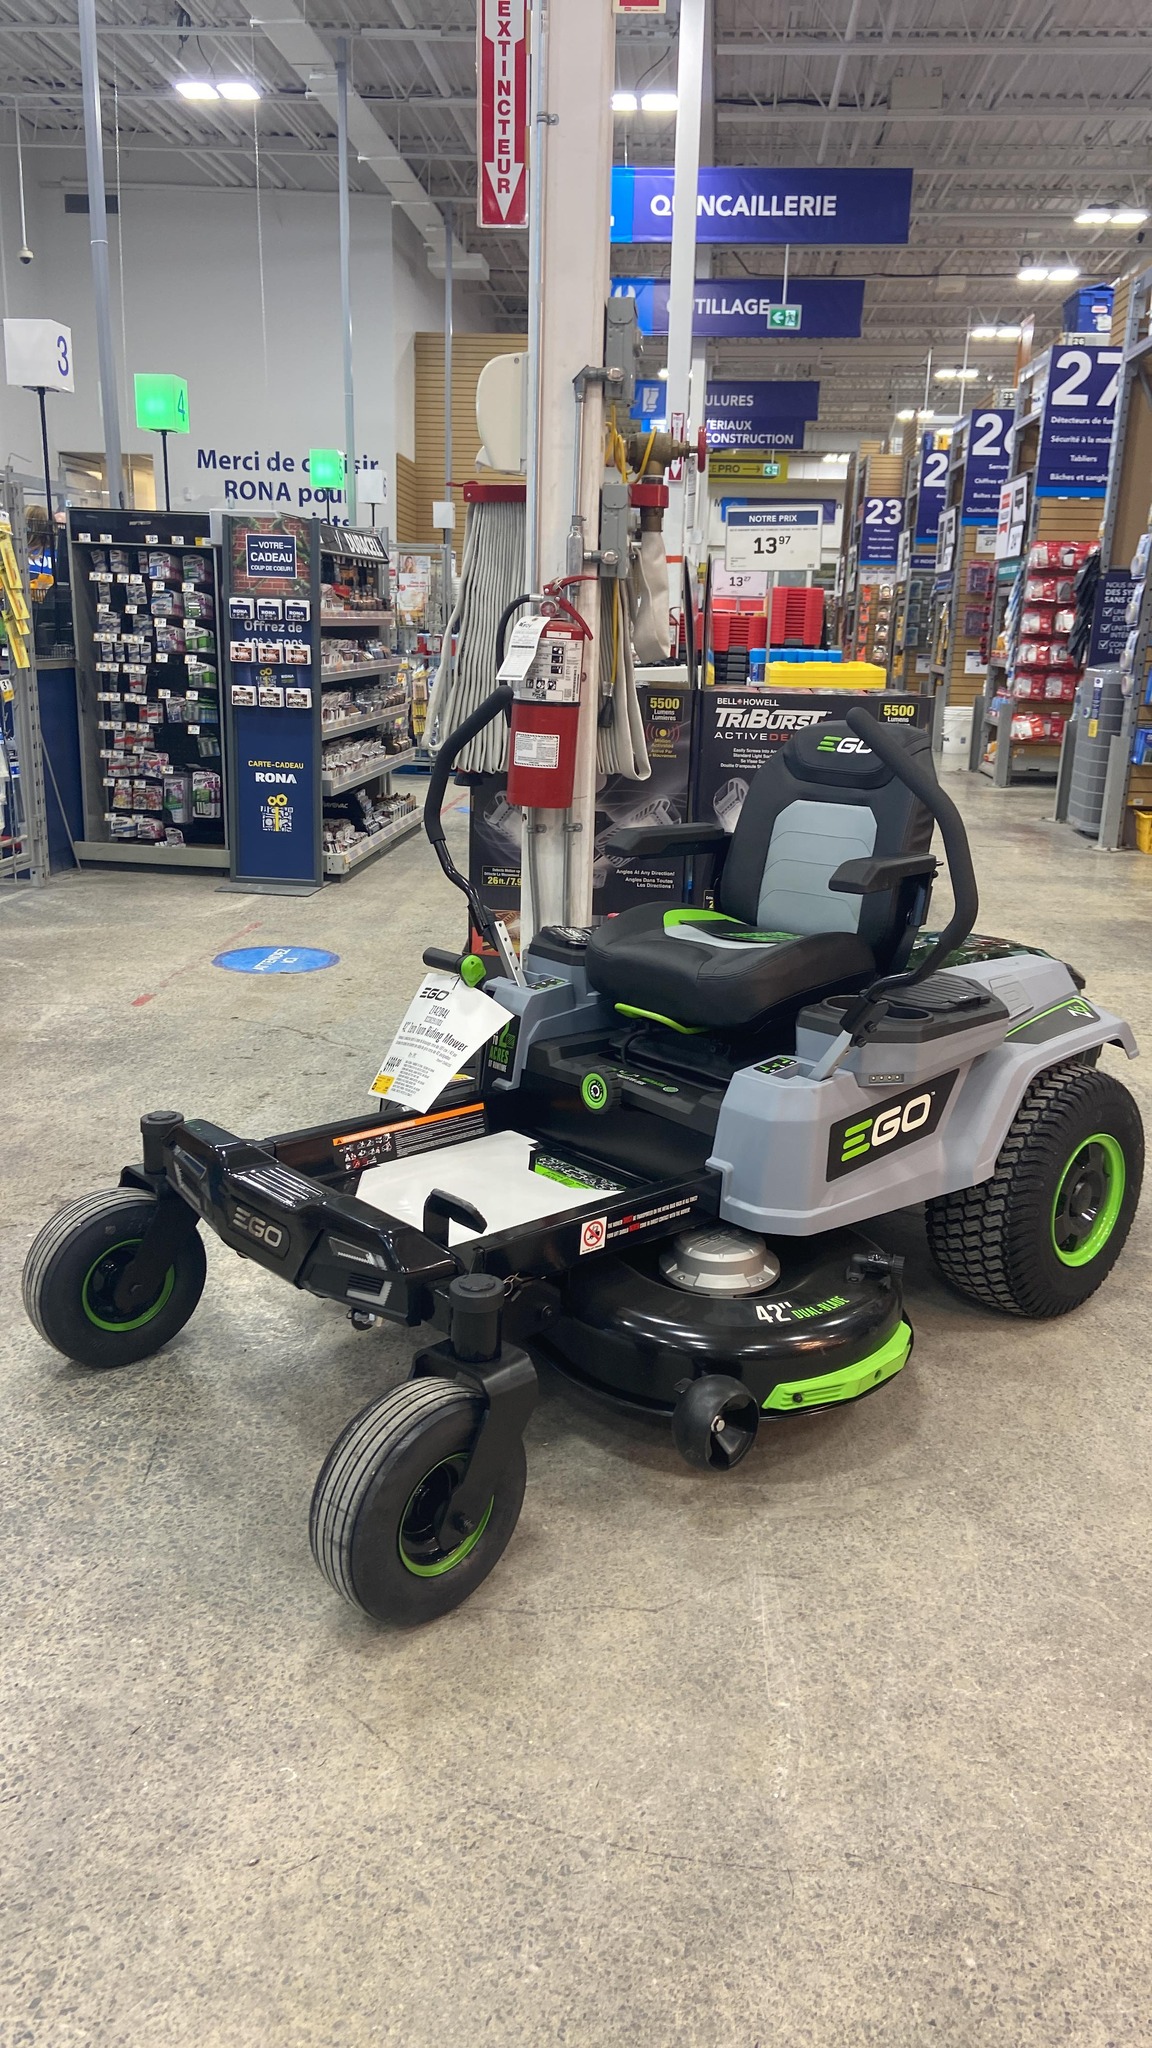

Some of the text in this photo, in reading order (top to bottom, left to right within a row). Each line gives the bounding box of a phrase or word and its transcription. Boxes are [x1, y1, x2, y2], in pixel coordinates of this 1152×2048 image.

[497, 1, 512, 194] EXTINCTEUR
[650, 195, 837, 217] QNCAILLERIE
[667, 298, 769, 315] TILLAGE
[57, 335, 69, 376] 3
[1051, 350, 1123, 406] 27
[177, 389, 185, 421] 4
[705, 394, 754, 407] ULURES
[1051, 416, 1090, 424] Détecteurs
[1050, 435, 1080, 443] Sécurité
[198, 450, 260, 471] Merci
[267, 452, 294, 473] de
[923, 453, 949, 488] 2
[1049, 473, 1075, 481] Bâches
[225, 480, 291, 501] RONA
[865, 499, 902, 525] 23
[258, 541, 284, 549] VOTRE
[753, 536, 791, 554] 13 97
[250, 552, 293, 563] CADEAU
[729, 577, 743, 586] 13
[244, 621, 303, 633] Offrez de
[650, 697, 680, 709] 5500
[743, 698, 780, 706] HOWELL
[883, 704, 915, 716] 5500
[248, 760, 304, 769] CARTE-CADEAU
[255, 773, 297, 784] RONA
[420, 987, 450, 1001] EGO
[425, 1026, 444, 1043] Riding
[442, 1032, 468, 1052] Mower
[489, 1045, 510, 1064] ACRES
[841, 1093, 932, 1162] EGO
[232, 1206, 283, 1248] EGO
[755, 1295, 850, 1323] 42" DUAL-BLADE
